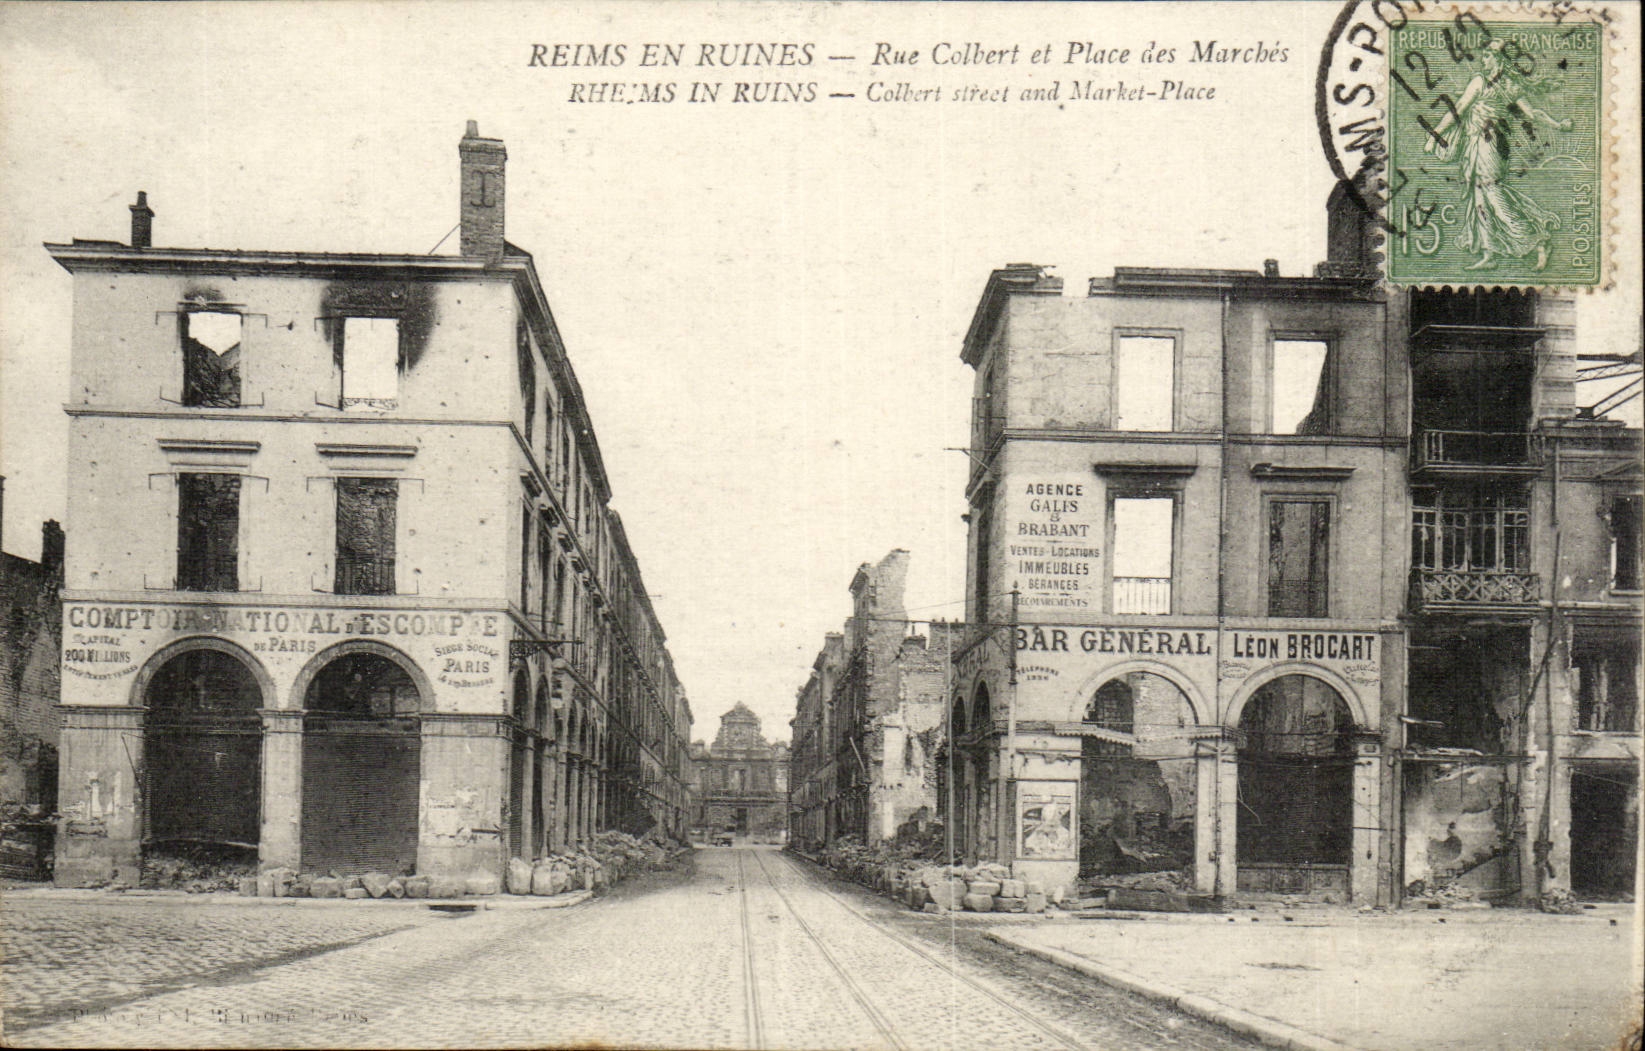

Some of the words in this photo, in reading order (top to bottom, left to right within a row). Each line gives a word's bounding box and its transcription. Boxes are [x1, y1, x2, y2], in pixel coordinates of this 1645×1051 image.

[1400, 31, 1483, 49] REPUBIQUE
[1572, 182, 1592, 268] POSTES
[1025, 483, 1083, 497] AGENCE
[1017, 522, 1090, 537] BRABANT
[1051, 545, 1101, 558] LOCATIONS
[1019, 560, 1089, 575] IMMEUBLES
[268, 636, 316, 653] PARIS
[1233, 632, 1280, 658] LÉON
[1287, 634, 1375, 660] BROCART
[65, 648, 85, 662] 200
[443, 658, 490, 674] PARIS
